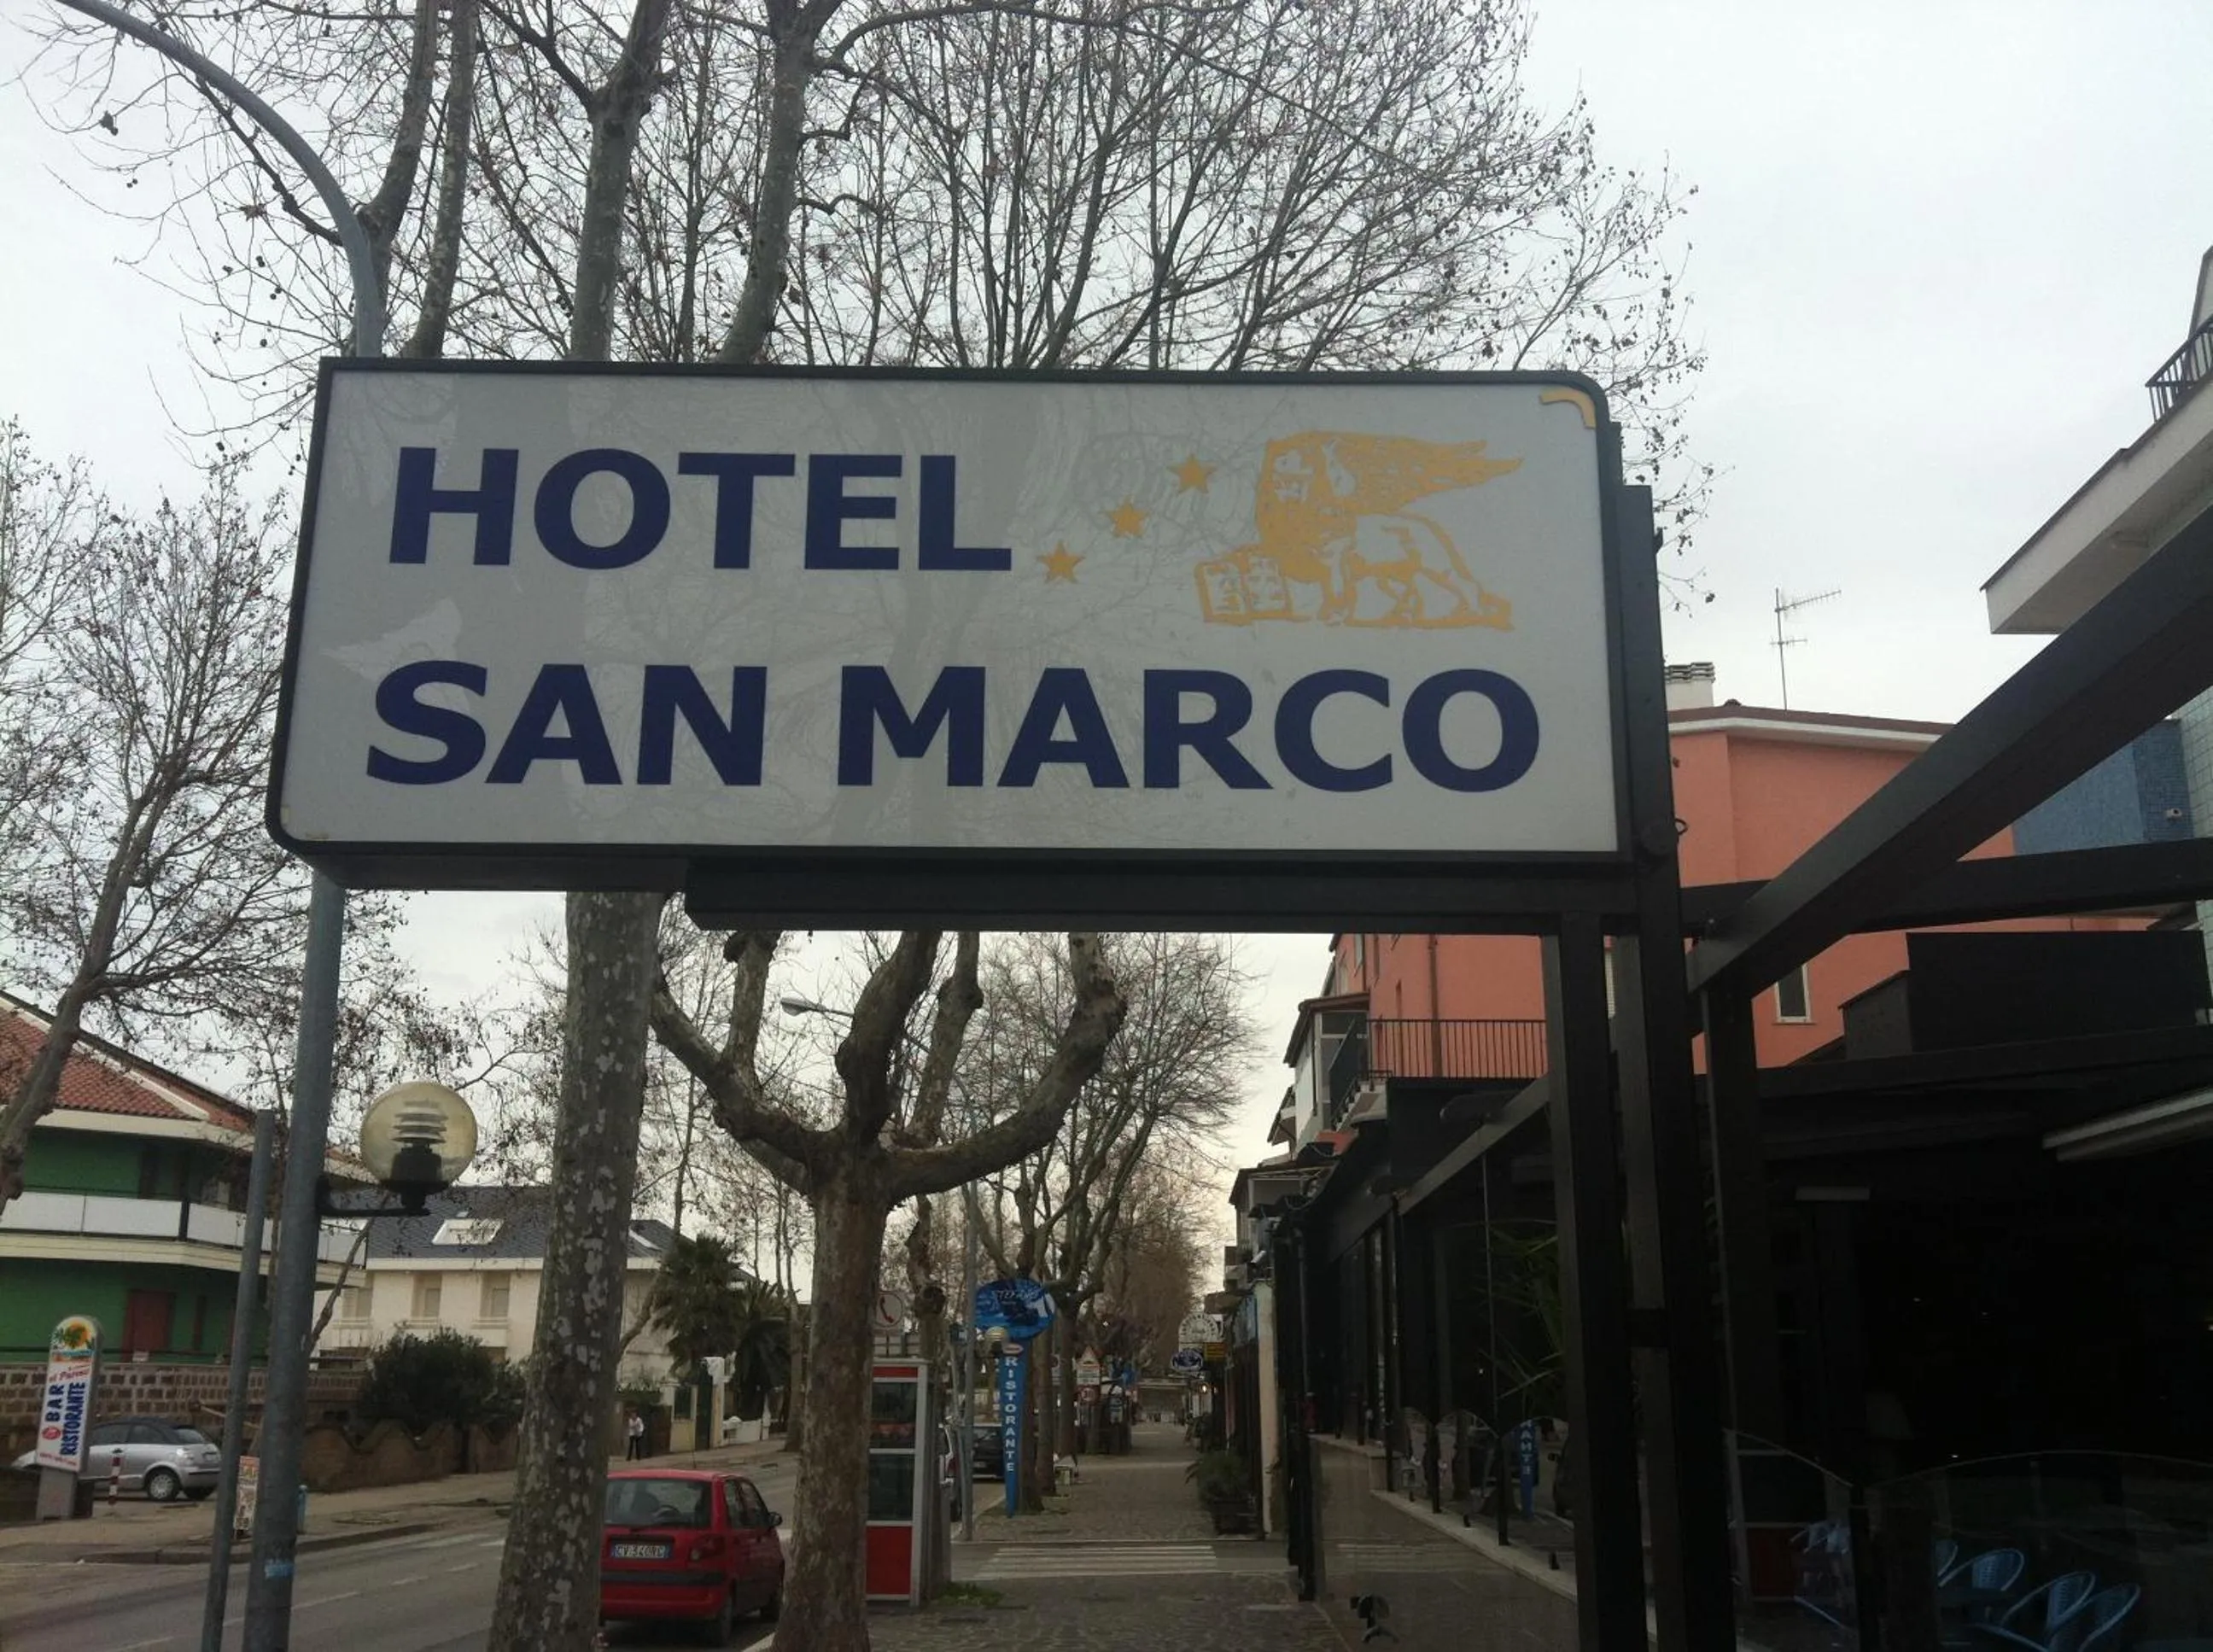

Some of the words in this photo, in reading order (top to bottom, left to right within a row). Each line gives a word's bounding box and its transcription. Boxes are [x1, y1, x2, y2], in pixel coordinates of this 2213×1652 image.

[389, 447, 1012, 571] HOTEL
[366, 660, 765, 785] SAN
[838, 665, 1540, 793] MARCO
[45, 1385, 64, 1421] BAR
[61, 1382, 85, 1455] RISTORANTE
[1004, 1357, 1018, 1472] RISTORANTE
